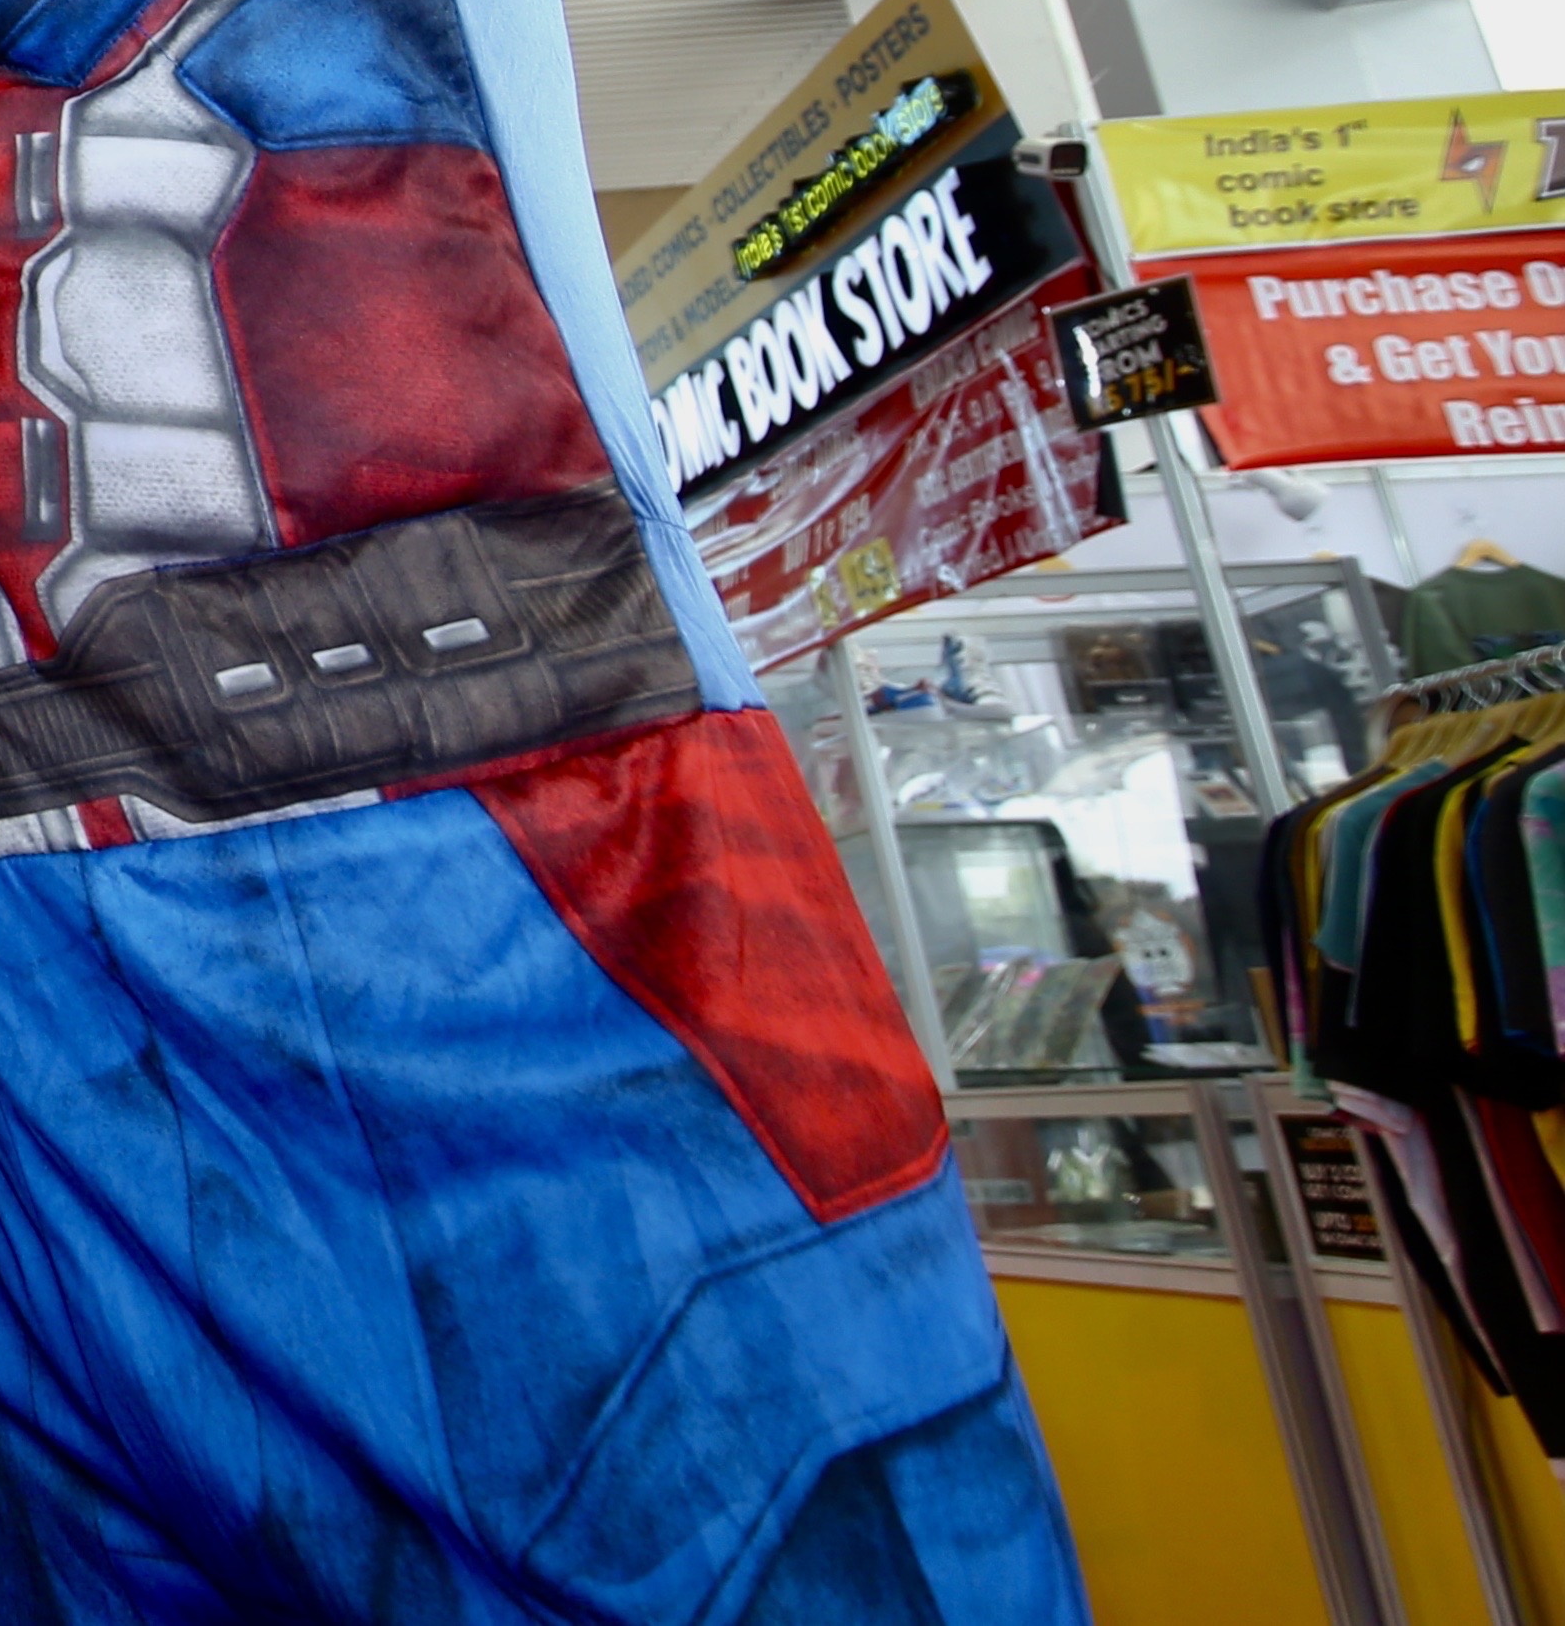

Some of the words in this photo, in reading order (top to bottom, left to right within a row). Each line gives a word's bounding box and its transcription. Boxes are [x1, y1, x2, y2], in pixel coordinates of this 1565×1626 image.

[835, 3, 931, 106] POSTERS
[1204, 126, 1322, 157] India's
[1216, 163, 1324, 192] comic
[1229, 199, 1318, 228] book
[1326, 197, 1420, 222] store
[724, 276, 853, 443] BOOK
[832, 166, 993, 368] STORE
[1246, 269, 1521, 321] Purchase
[1522, 260, 1565, 307] O
[1091, 338, 1164, 383] ROM
[1324, 343, 1373, 386] &
[1372, 333, 1480, 383] Get
